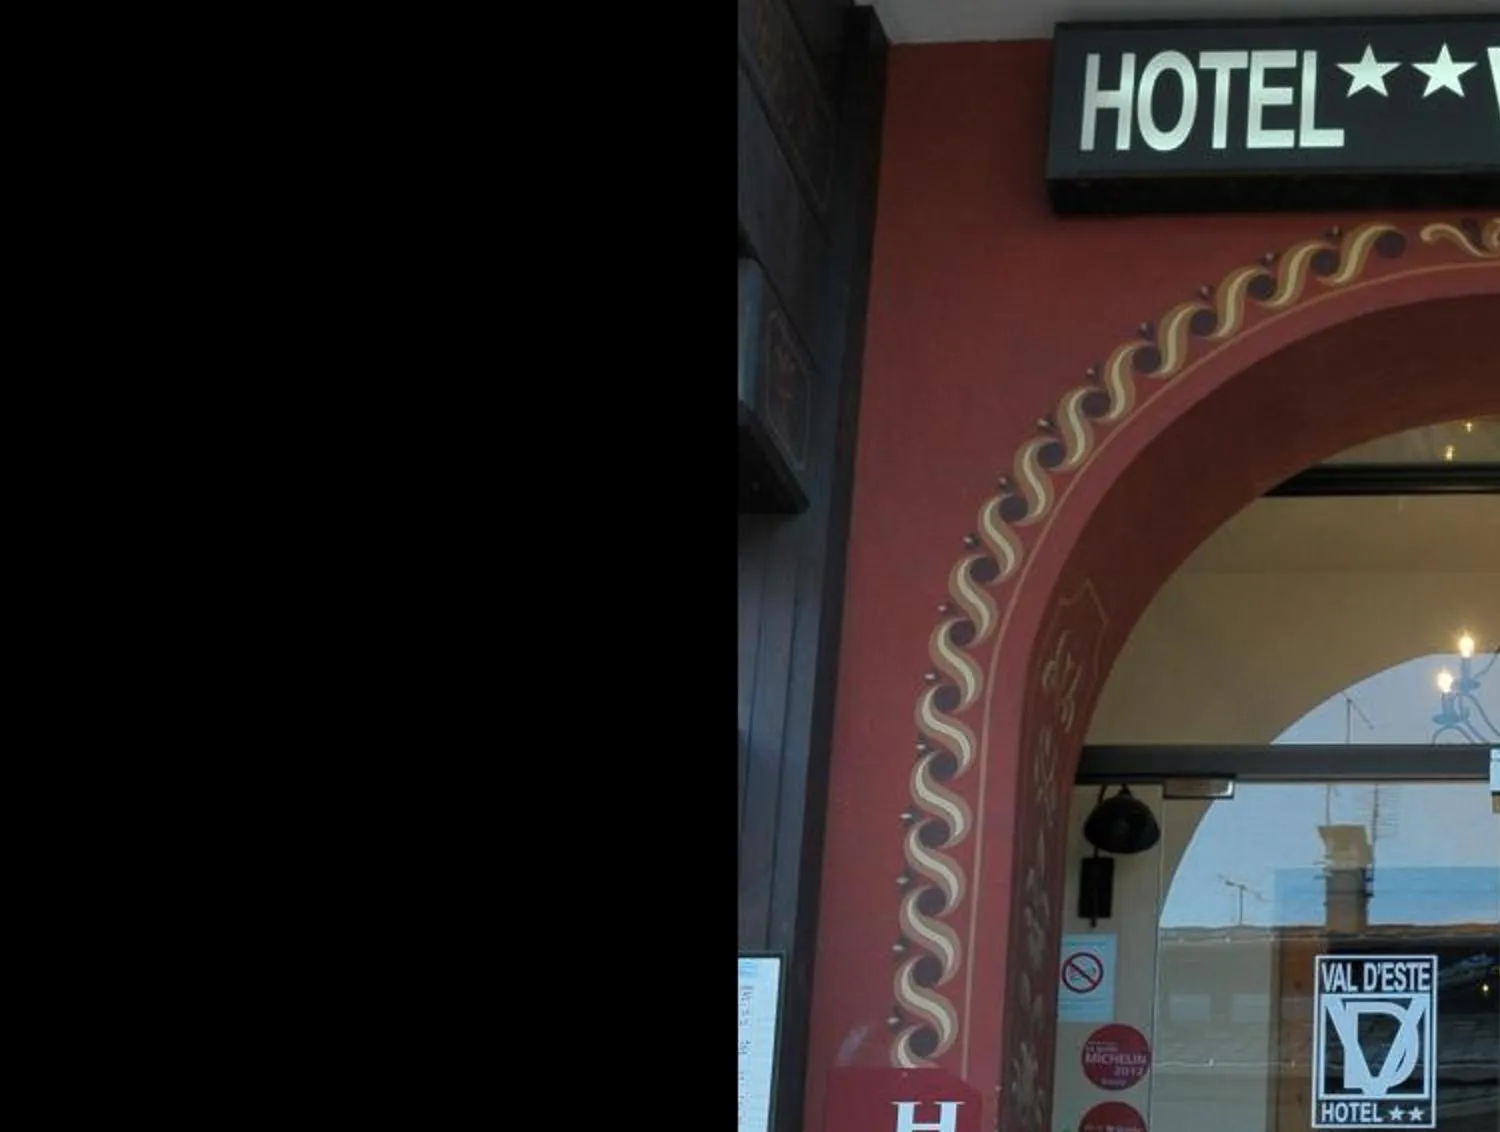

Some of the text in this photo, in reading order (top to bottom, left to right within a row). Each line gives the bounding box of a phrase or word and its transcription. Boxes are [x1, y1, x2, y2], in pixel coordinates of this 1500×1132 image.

[1079, 49, 1345, 152] HOTEL
[1321, 961, 1431, 993] VAL D'ESTE
[1085, 1052, 1148, 1066] MICHELIN
[1321, 1103, 1383, 1123] HOTEL
